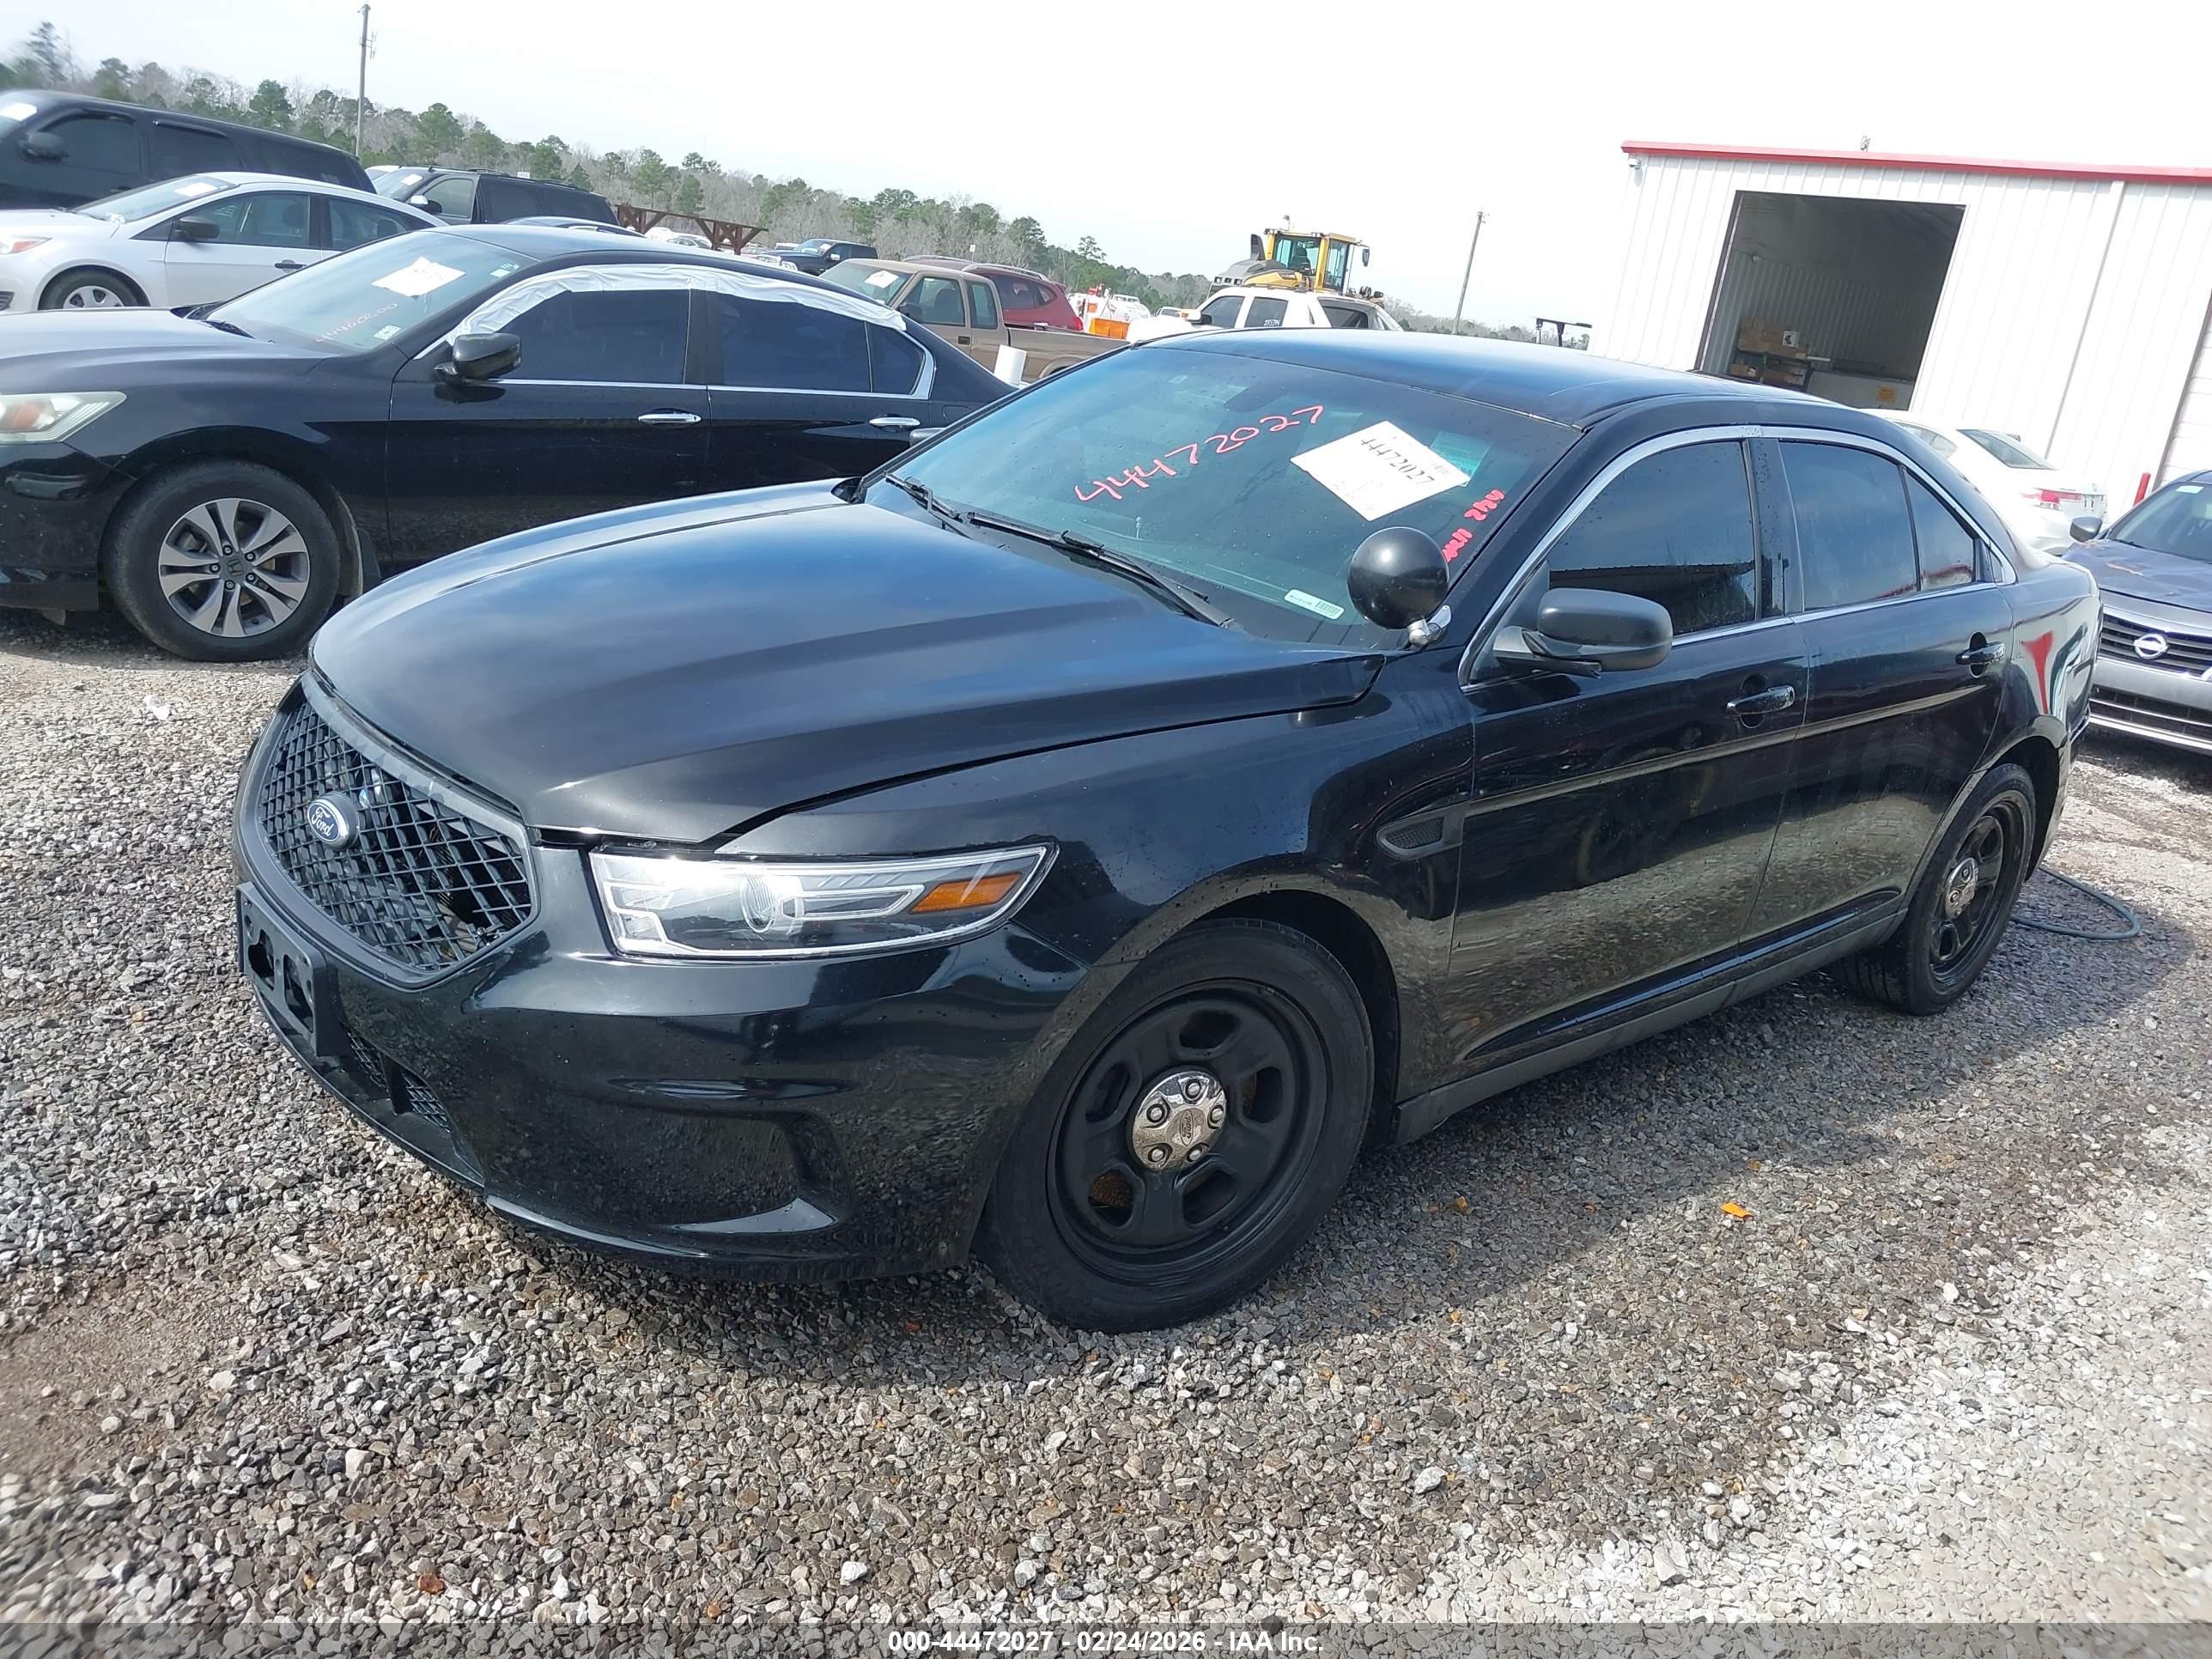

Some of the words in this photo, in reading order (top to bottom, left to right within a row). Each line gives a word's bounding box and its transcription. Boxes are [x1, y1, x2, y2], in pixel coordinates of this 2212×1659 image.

[1074, 405, 1324, 501] 44472027
[1360, 437, 1436, 485] 44472027
[311, 805, 336, 837] Ford
[1182, 1115, 1192, 1139] Ford
